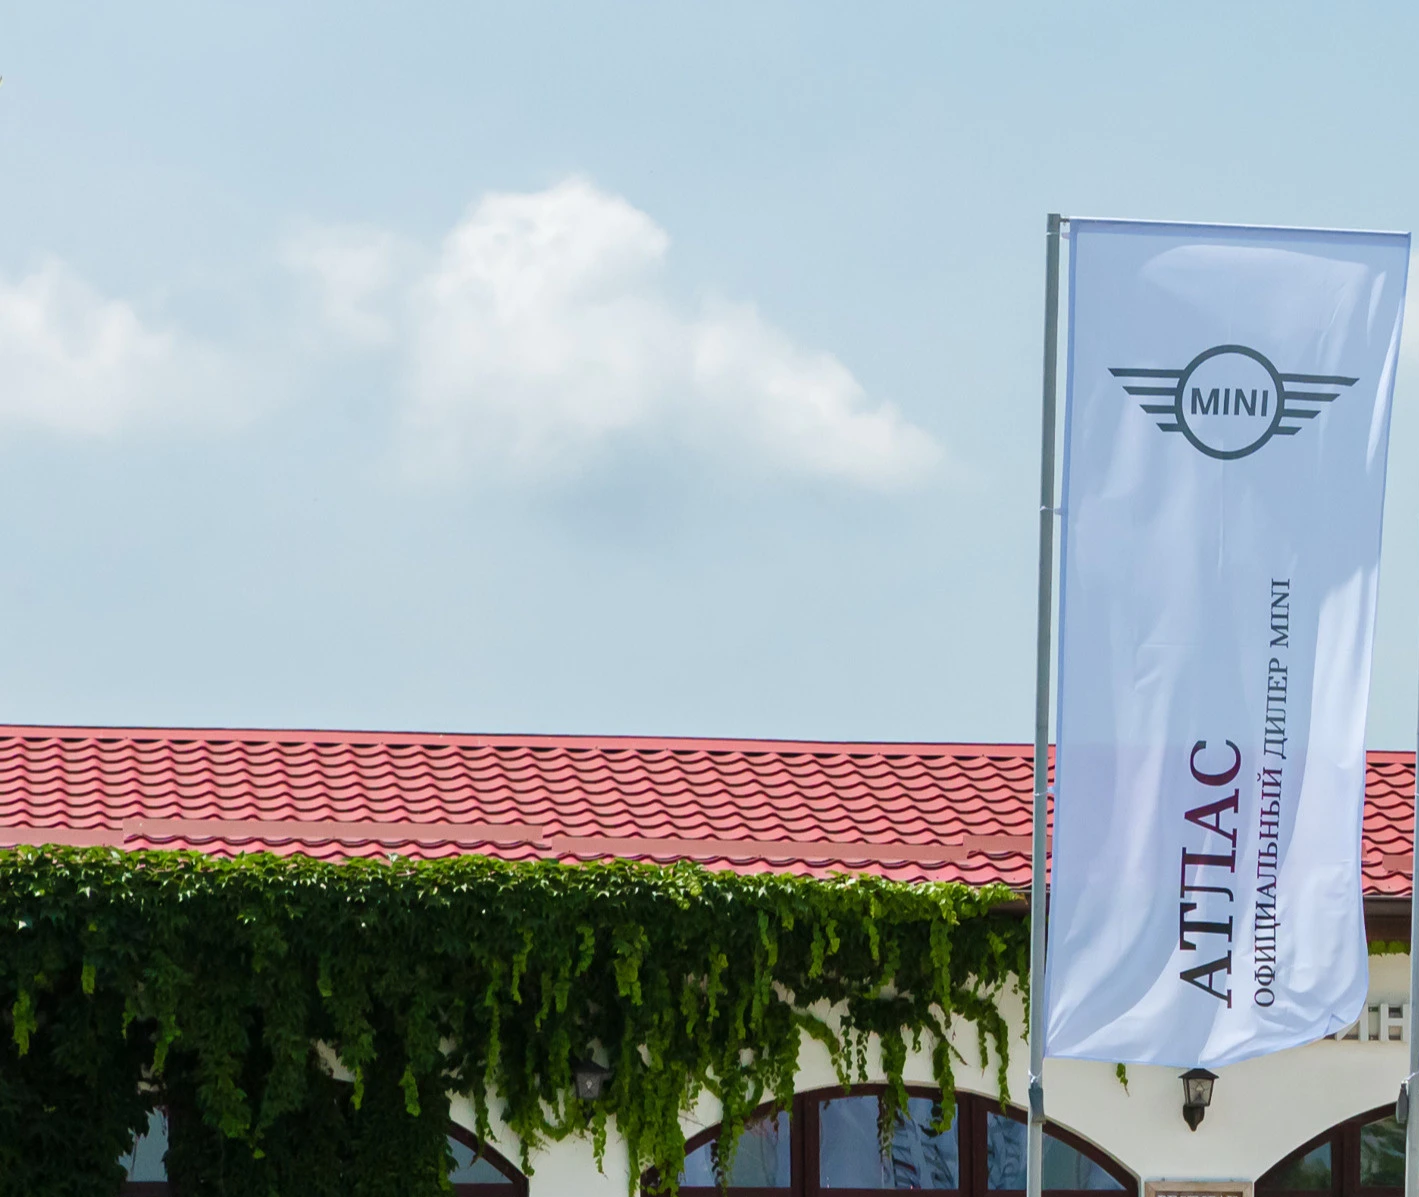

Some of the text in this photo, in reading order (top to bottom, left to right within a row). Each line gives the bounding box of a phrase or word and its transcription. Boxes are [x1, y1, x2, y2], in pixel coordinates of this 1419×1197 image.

[1190, 388, 1269, 416] MINI
[1179, 739, 1242, 1009] АТЛАС
[1253, 578, 1291, 1008] ОФИЦИАЛЬНЫЙ ДИЛЕР MINI
